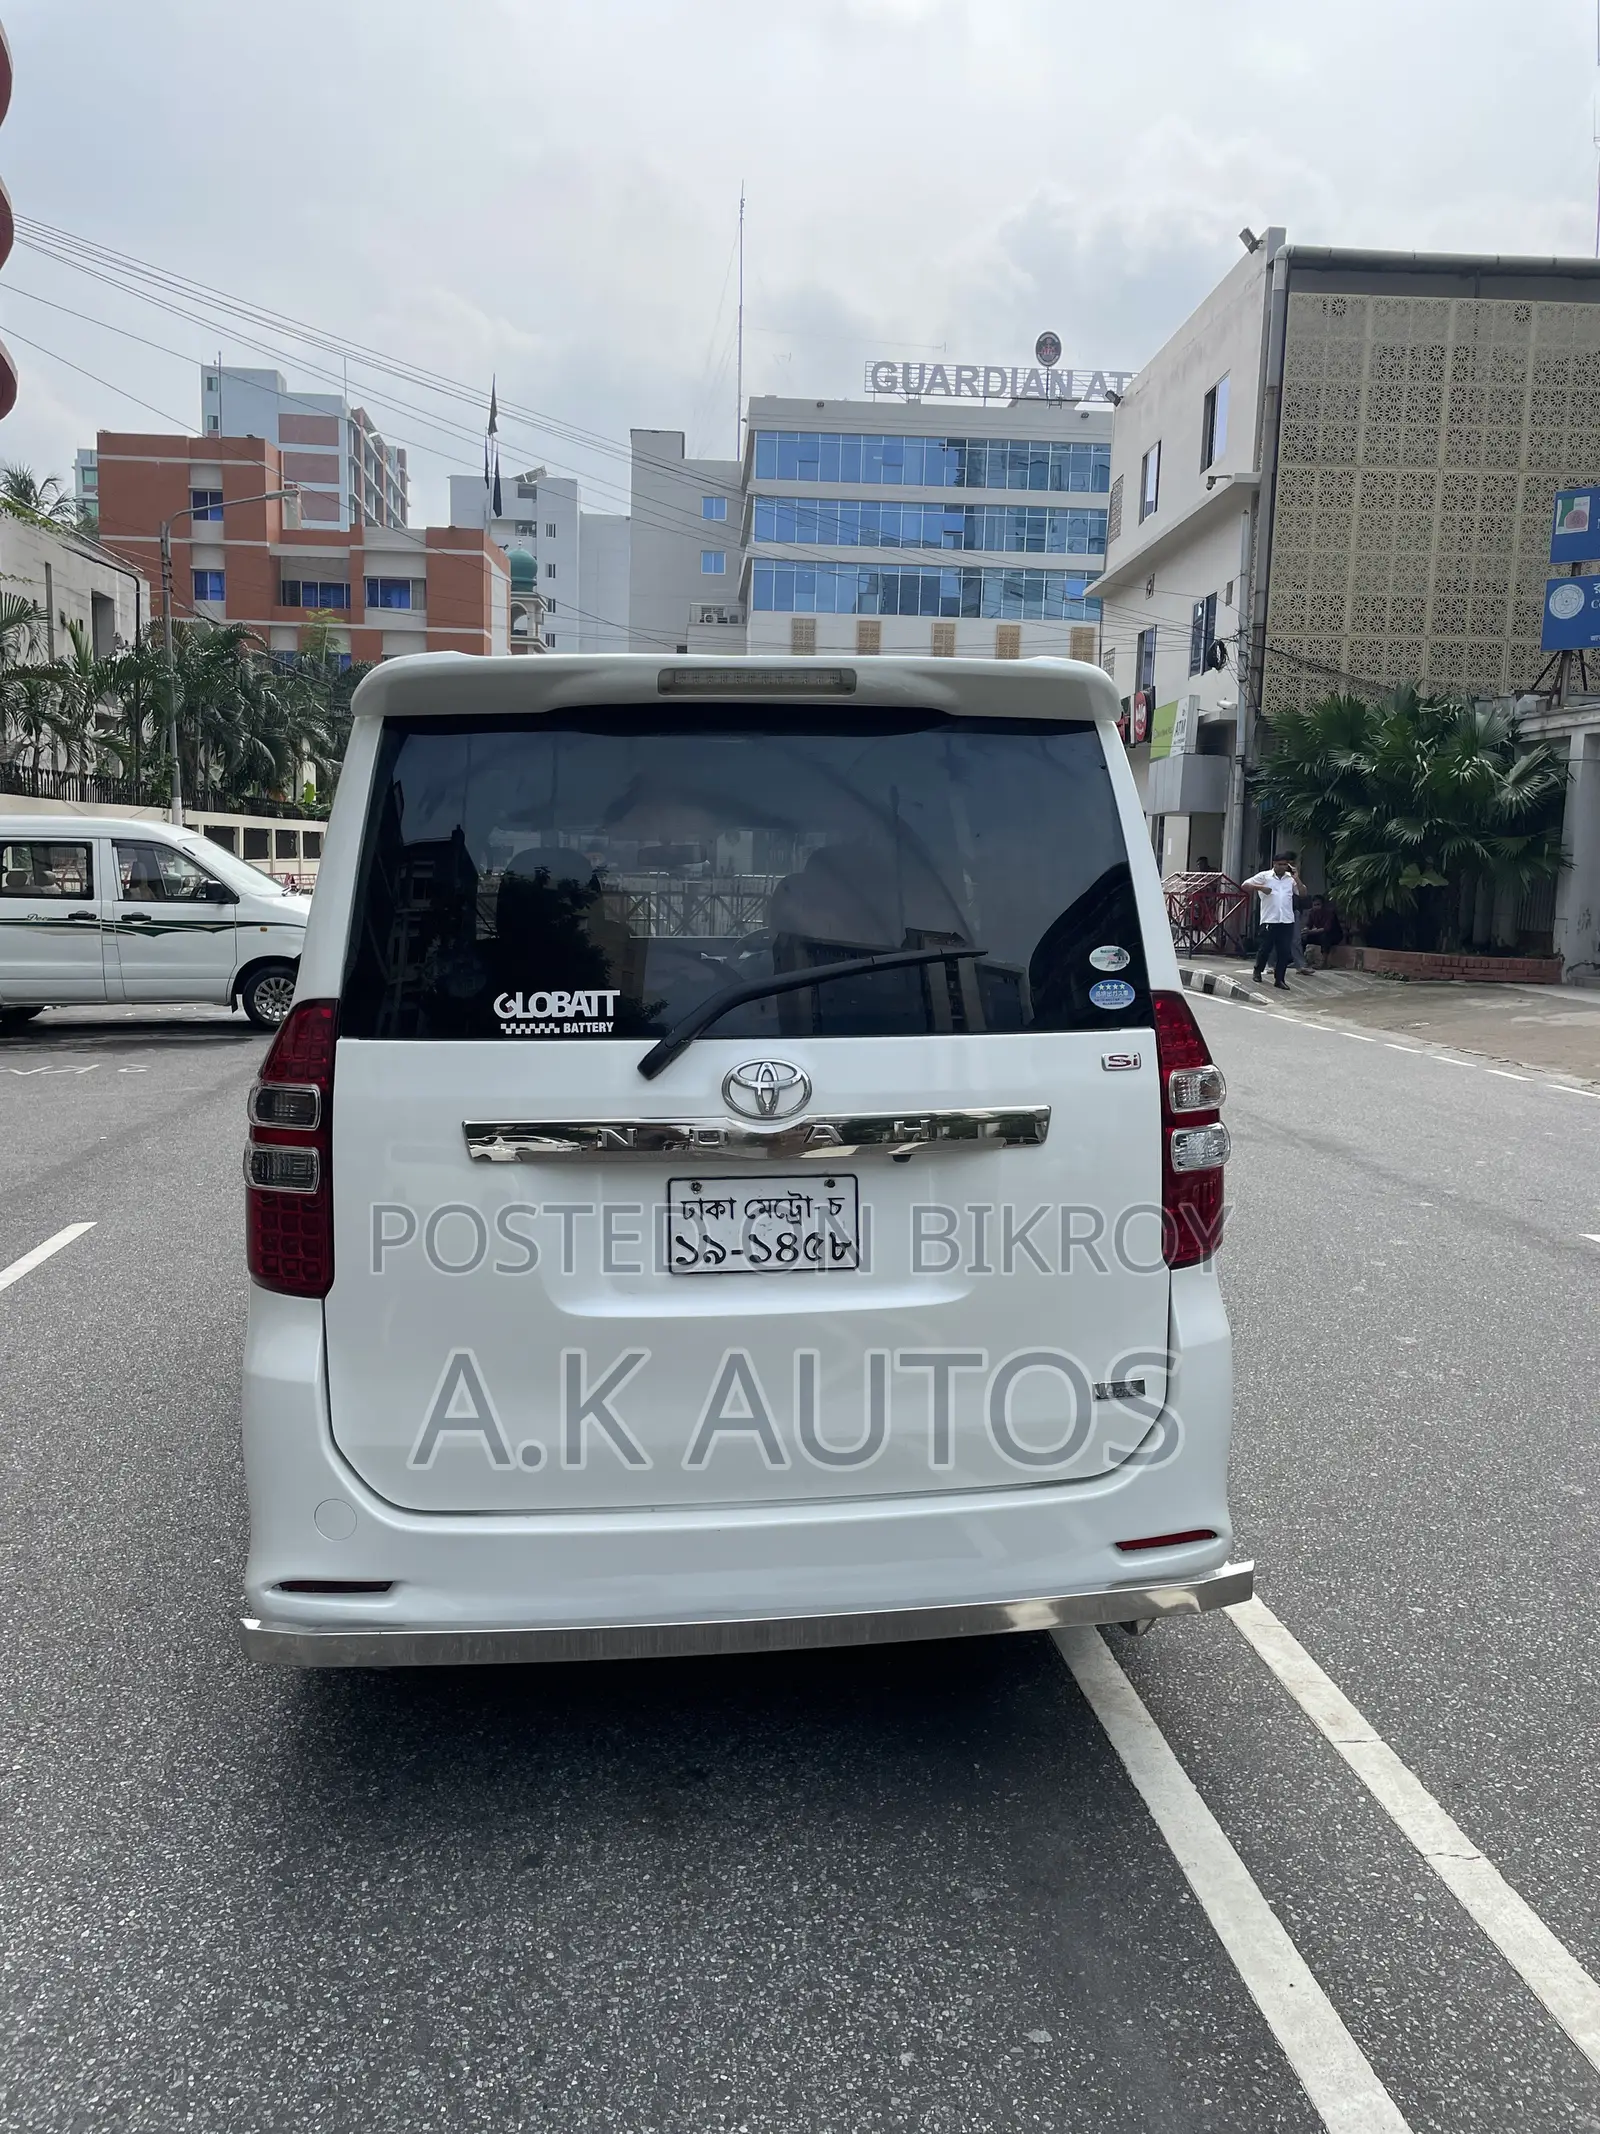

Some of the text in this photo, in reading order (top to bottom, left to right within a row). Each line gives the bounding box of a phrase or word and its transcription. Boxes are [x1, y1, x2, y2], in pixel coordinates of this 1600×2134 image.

[871, 361, 1073, 399] GUARDIAN
[493, 990, 620, 1019] GLOBATT
[563, 1022, 614, 1033] BATTERY
[1108, 1054, 1138, 1068] Si
[680, 1197, 737, 1220] ঢাকা
[675, 1231, 852, 1265] ১৯-১৪৫৮
